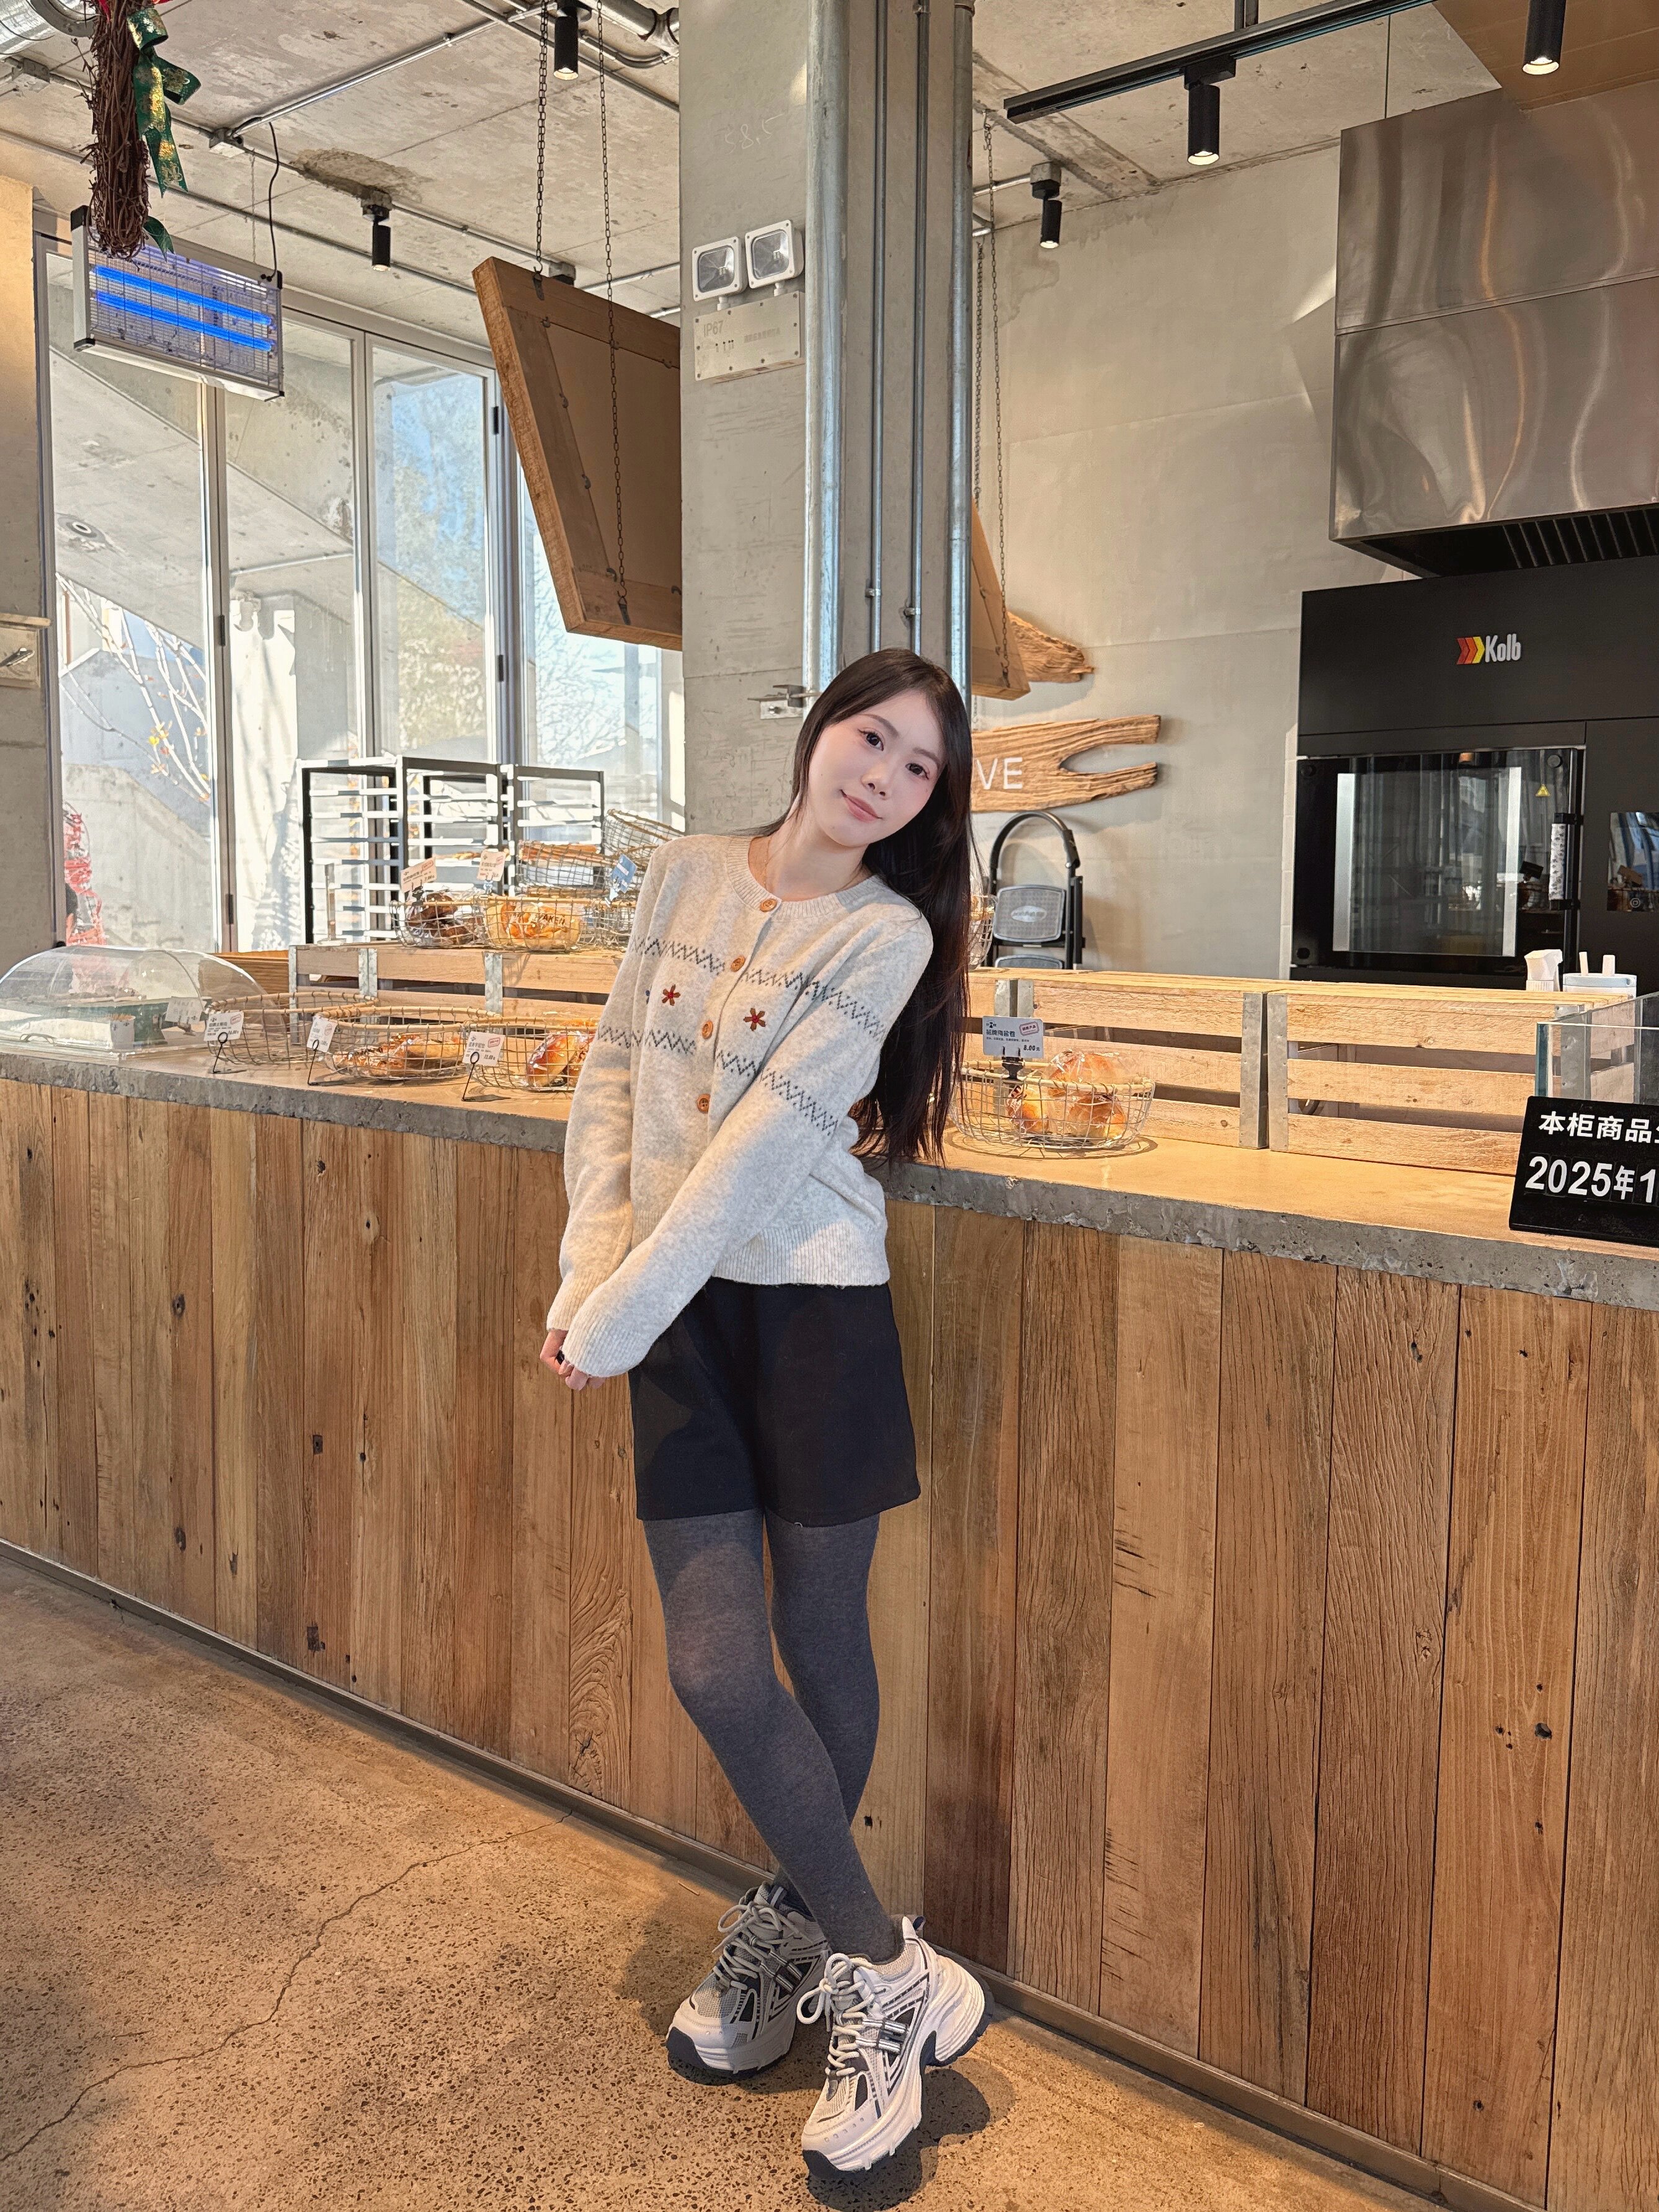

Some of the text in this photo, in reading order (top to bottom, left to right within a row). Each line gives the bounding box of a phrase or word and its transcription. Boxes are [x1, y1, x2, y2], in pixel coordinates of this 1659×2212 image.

[703, 320, 724, 338] IP67
[1485, 633, 1521, 663] Kolb
[1538, 1111, 1659, 1144] 本柜商品
[1525, 1156, 1656, 1203] 2025年1
